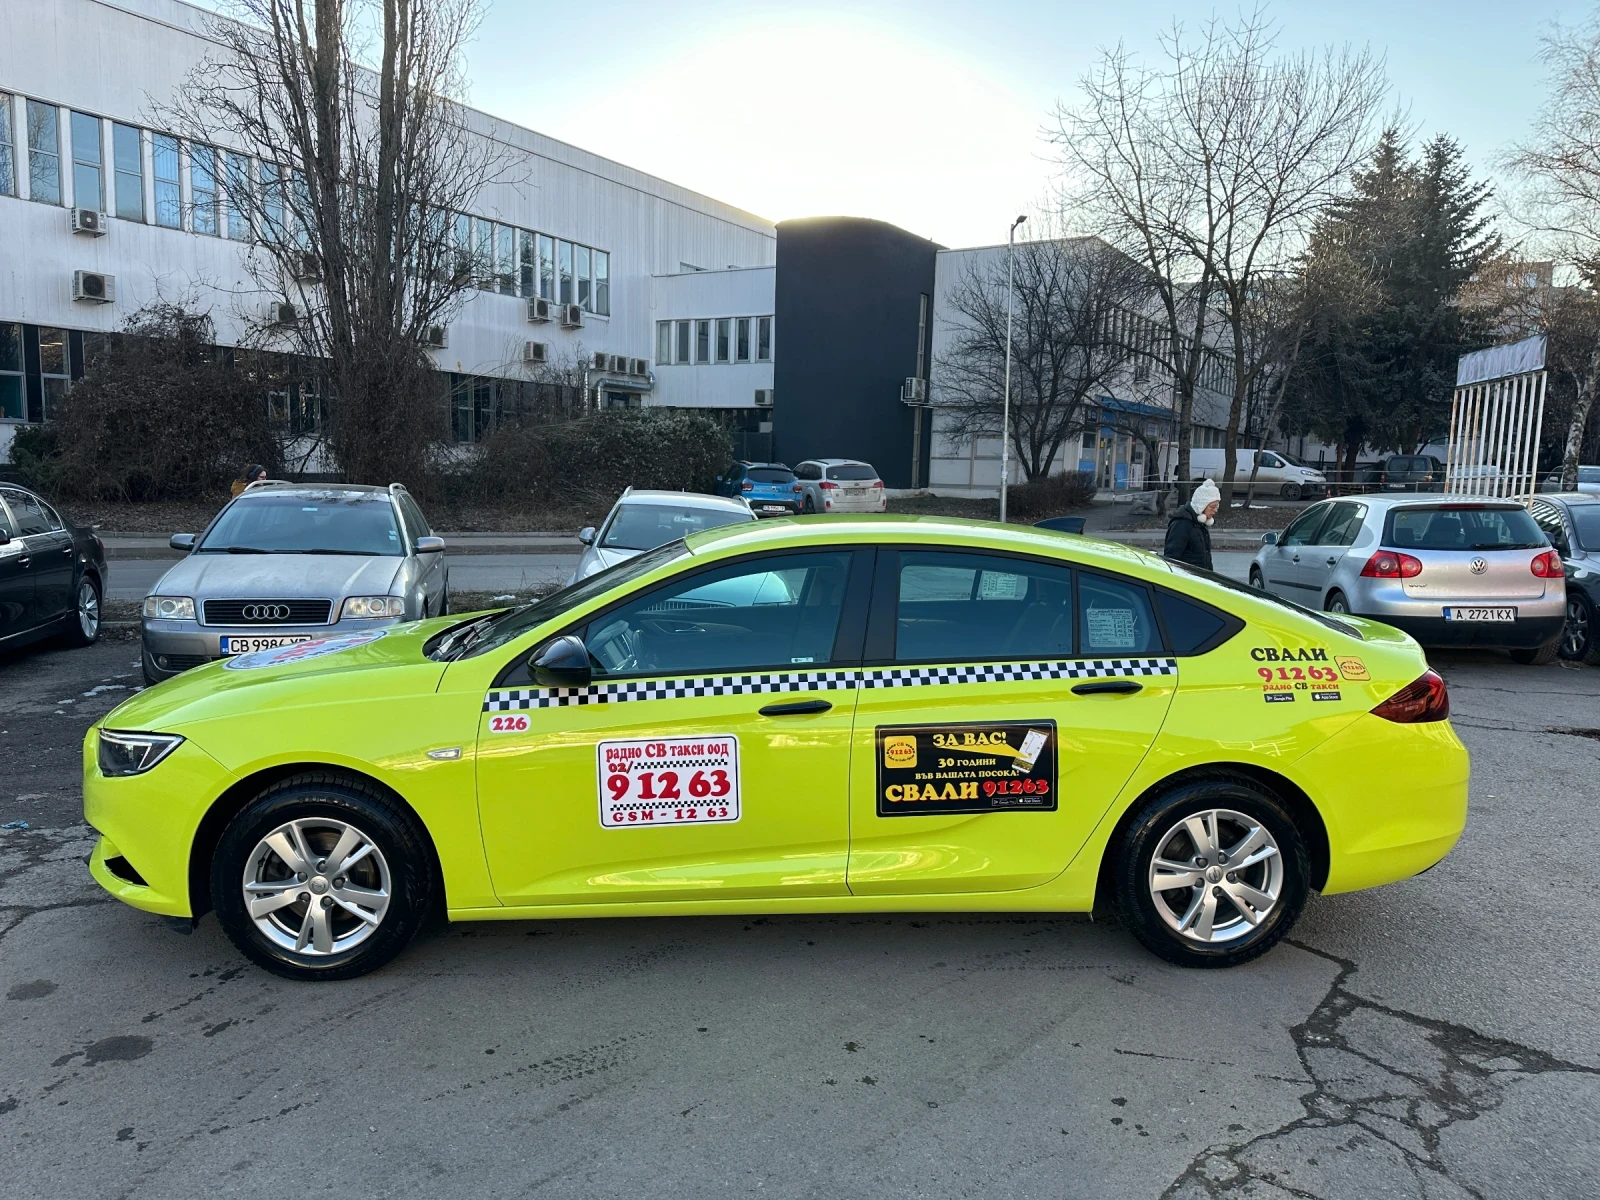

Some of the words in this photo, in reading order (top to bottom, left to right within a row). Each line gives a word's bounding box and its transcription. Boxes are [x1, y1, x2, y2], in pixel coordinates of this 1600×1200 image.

[1456, 610, 1463, 619] A
[1468, 610, 1494, 620] 2721
[1497, 610, 1512, 620] KX
[231, 640, 249, 652] CB
[1250, 648, 1329, 661] СВАЛИ
[492, 716, 527, 731] 226
[932, 733, 959, 748] ЗА
[963, 731, 1007, 746] ВАС!
[606, 747, 642, 762] радио
[645, 743, 667, 758] СВ
[670, 744, 704, 757] такси
[707, 743, 729, 757] оод
[608, 761, 633, 774] 02/
[938, 758, 955, 768] 30
[957, 758, 996, 767] ГОДИНИ
[915, 772, 933, 780] ВЪВ
[935, 771, 977, 779] ВАШАТА
[978, 769, 1020, 778] ПОСОКА!
[885, 782, 979, 802] СВАЛИ
[982, 778, 1049, 797] 91263
[612, 810, 654, 822] GSM
[674, 808, 697, 819] 12
[707, 807, 728, 818] 63
